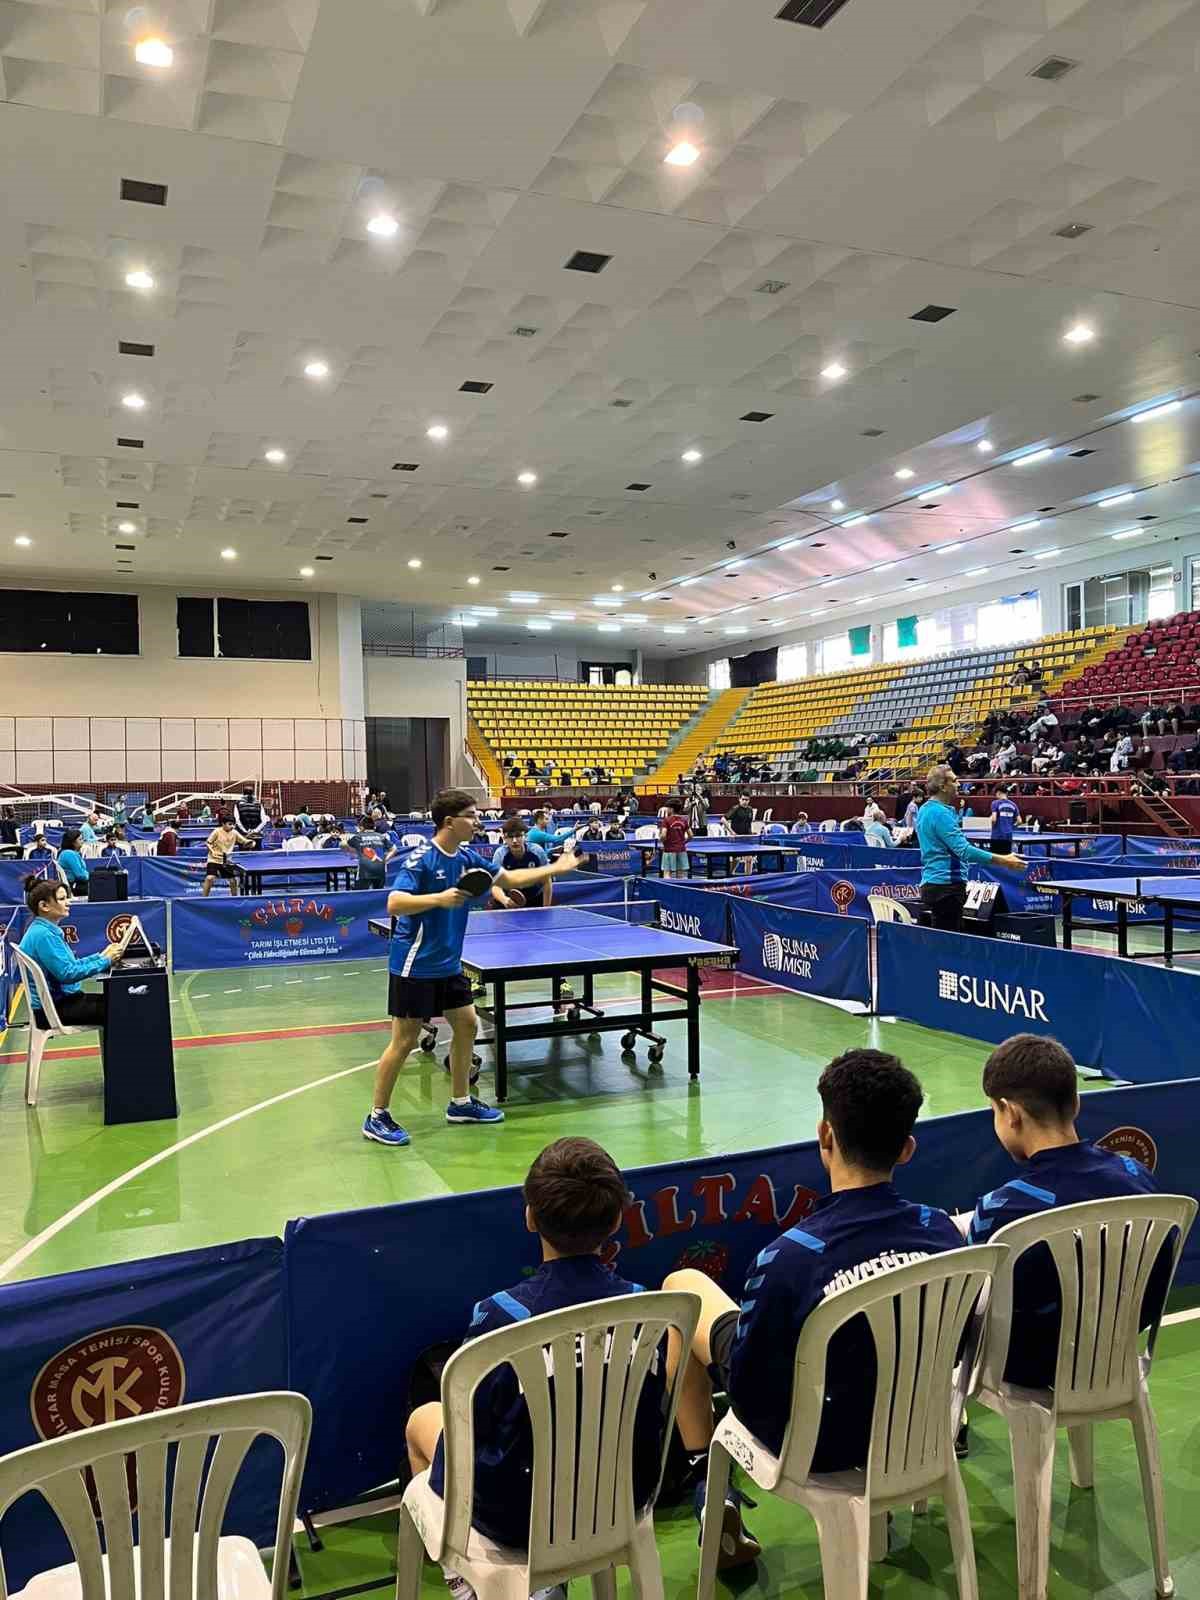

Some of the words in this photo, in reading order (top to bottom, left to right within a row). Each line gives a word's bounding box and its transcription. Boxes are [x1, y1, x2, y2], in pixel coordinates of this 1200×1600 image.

[667, 911, 702, 936] SUNAR
[250, 940, 272, 949] TARIM
[781, 937, 819, 961] SUNAR
[783, 957, 812, 979] MISIR
[959, 975, 1050, 1022] SUNAR
[49, 1357, 78, 1390] MASA
[79, 1335, 130, 1357] TENİSİ
[132, 1336, 165, 1365] SPOR
